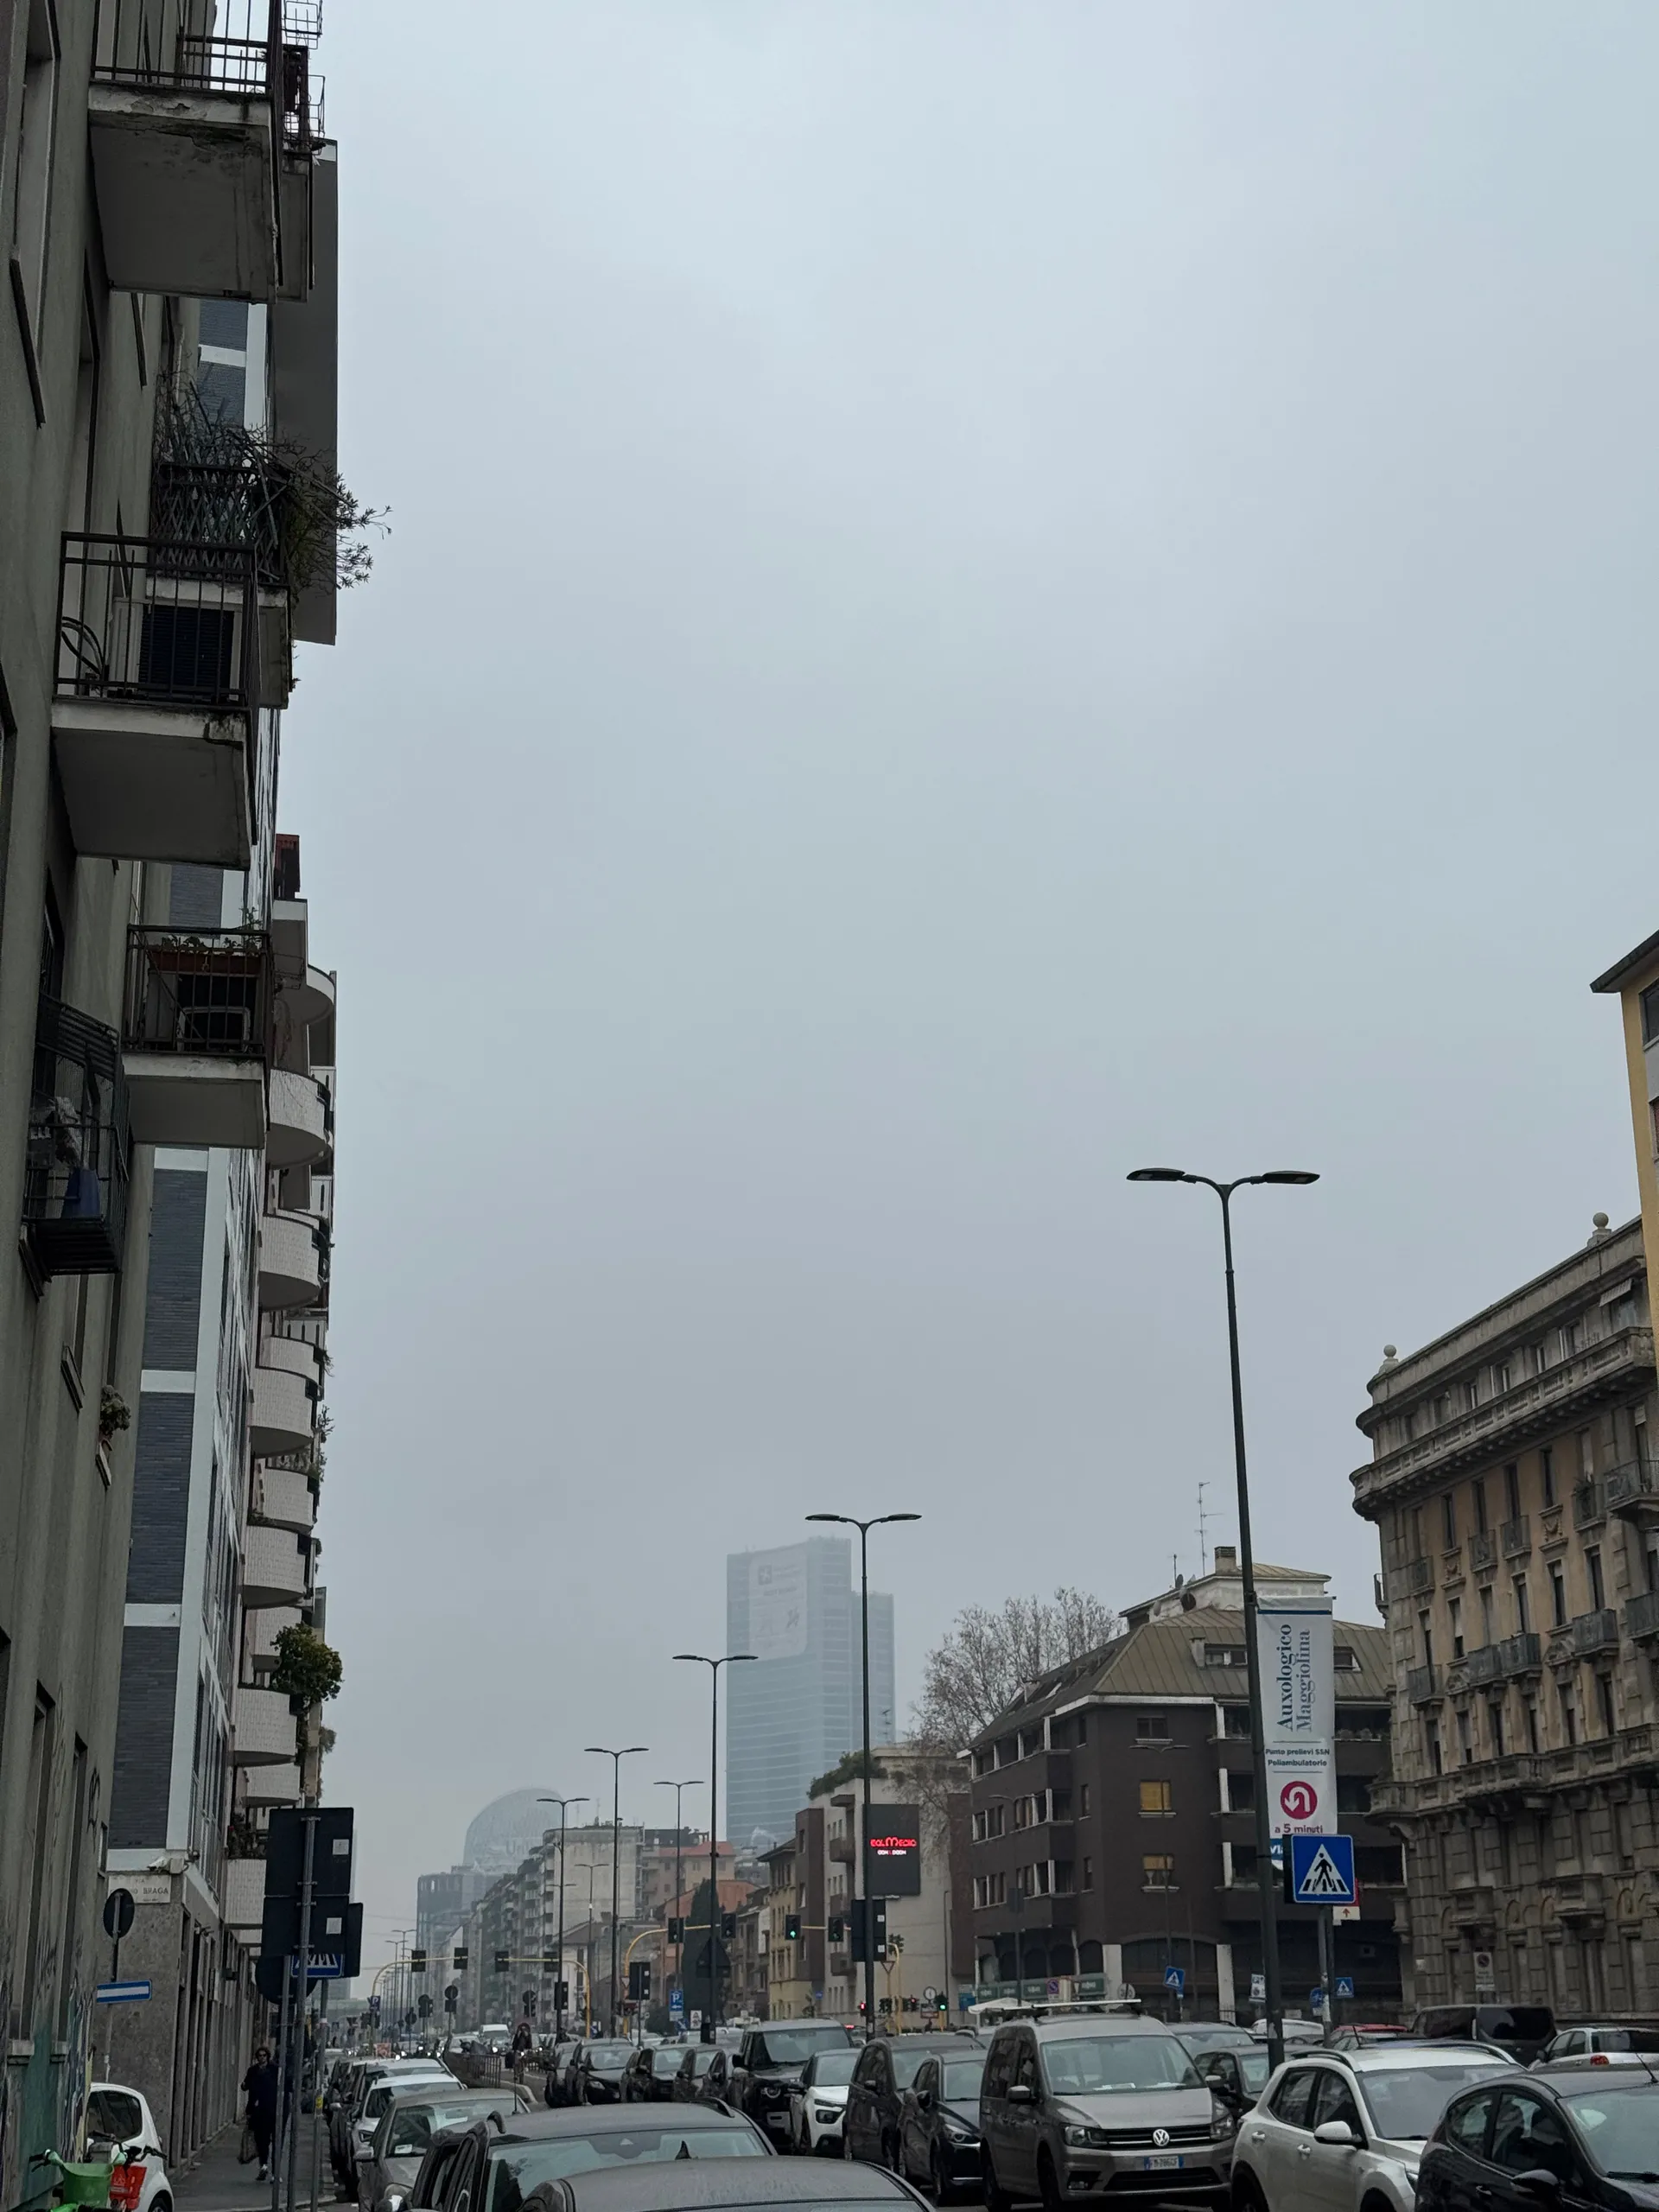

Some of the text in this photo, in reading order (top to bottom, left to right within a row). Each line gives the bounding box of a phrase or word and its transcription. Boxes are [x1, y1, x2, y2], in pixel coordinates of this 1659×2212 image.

[1276, 1624, 1296, 1732] Auxologico
[1296, 1628, 1316, 1732] Maggiolina
[1283, 1823, 1292, 1834] 5
[1294, 1825, 1324, 1834] minuti
[672, 1993, 680, 2003] P
